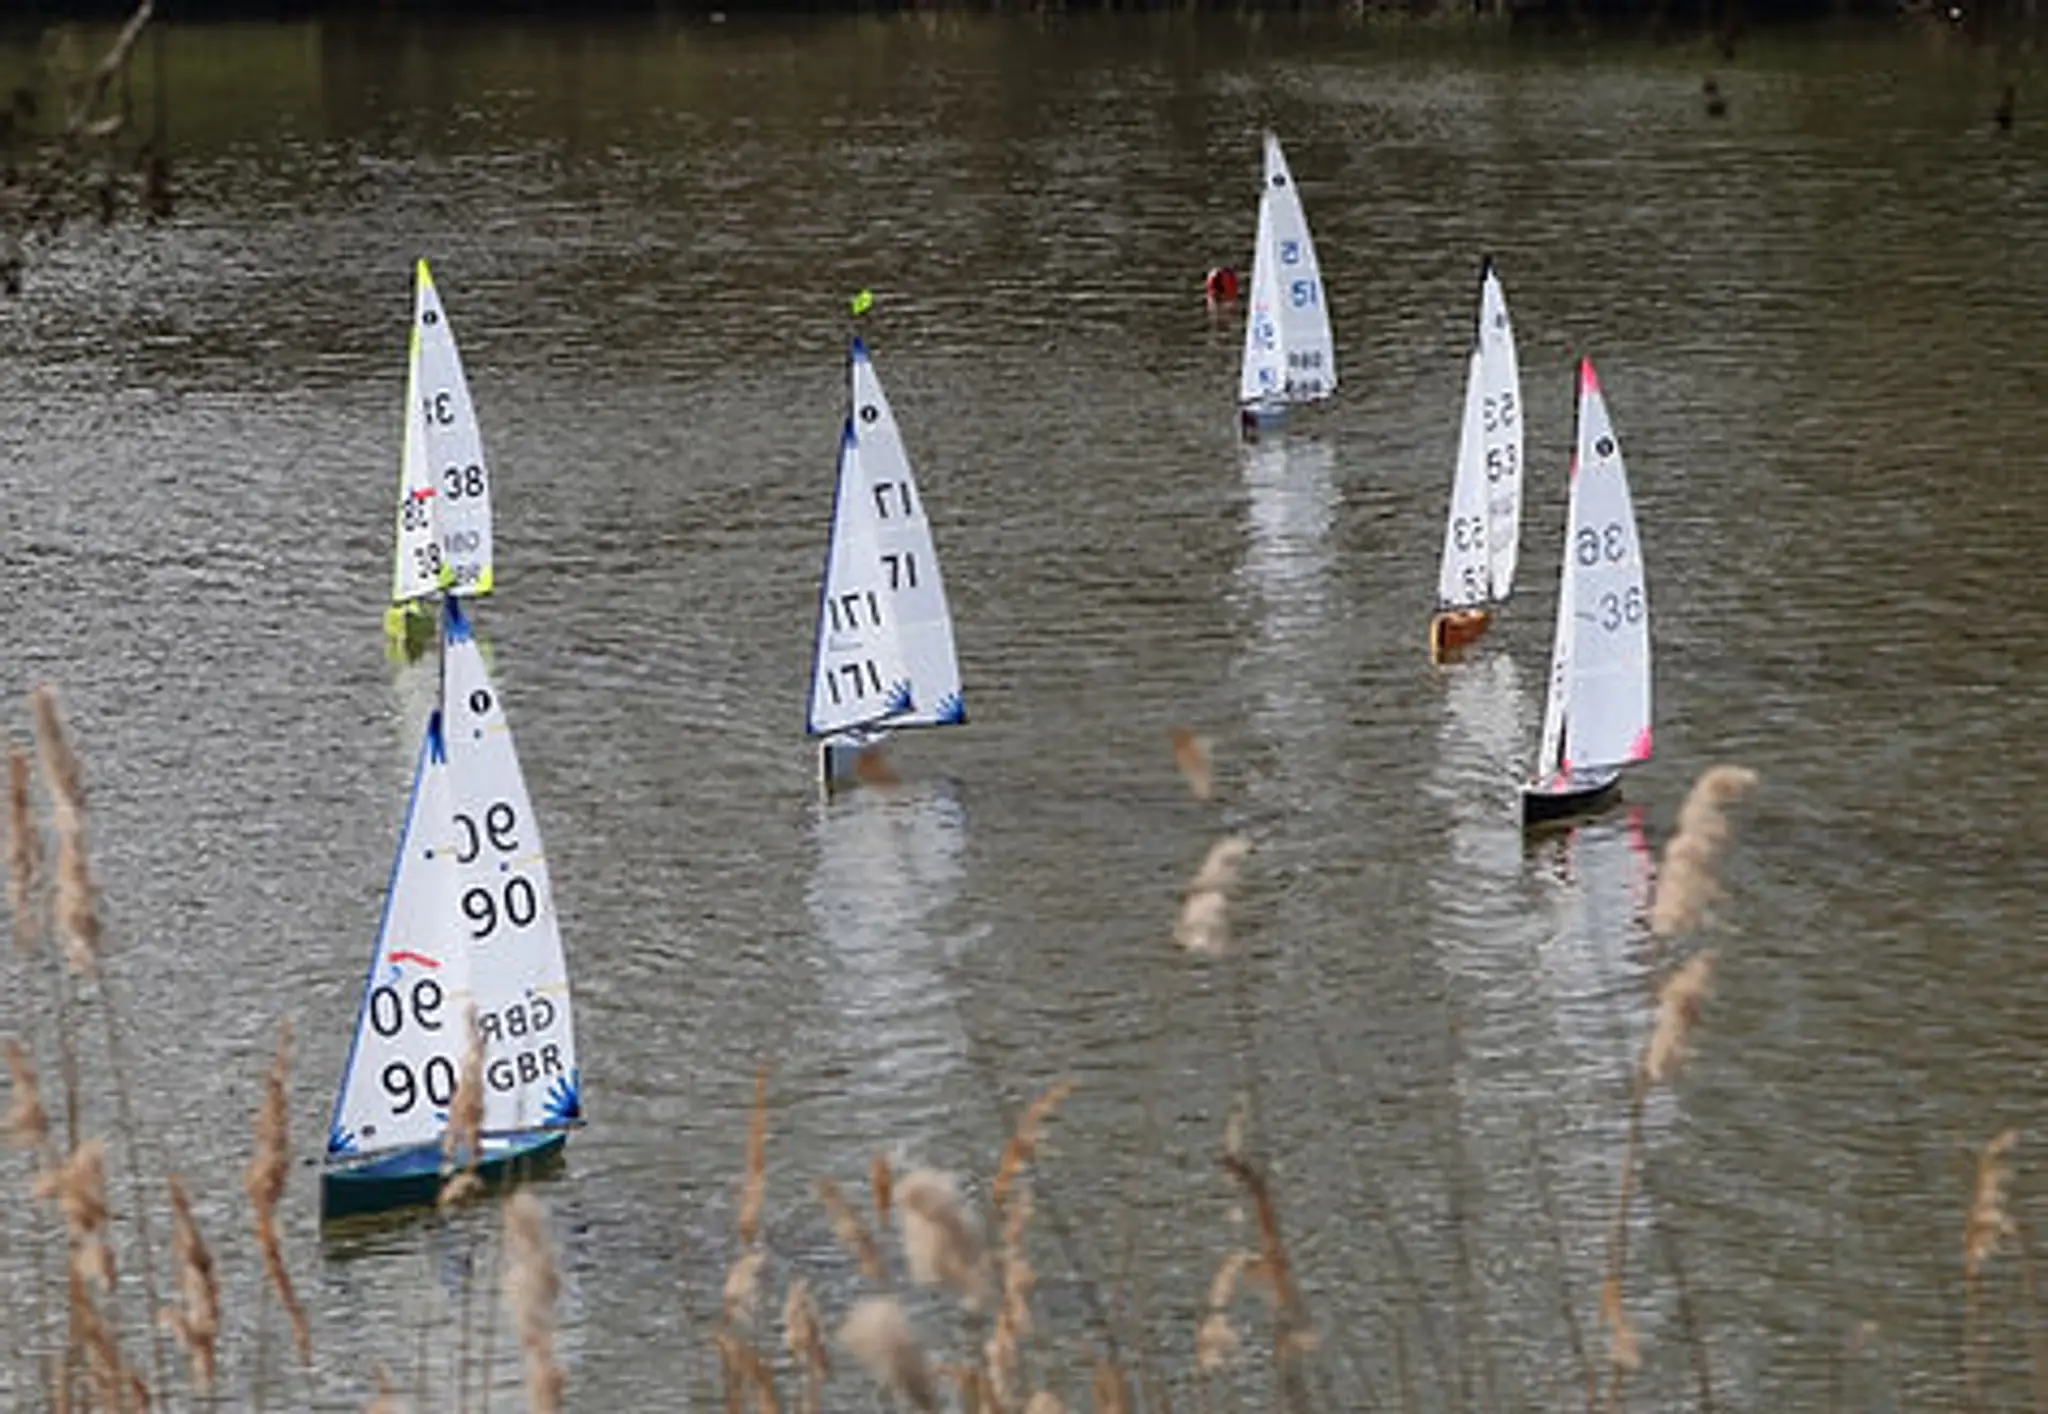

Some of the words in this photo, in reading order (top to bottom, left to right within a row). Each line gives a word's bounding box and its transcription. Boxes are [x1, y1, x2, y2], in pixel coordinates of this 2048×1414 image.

[1292, 279, 1317, 307] 51
[444, 465, 485, 500] 38
[1600, 586, 1644, 631] 36
[827, 659, 882, 704] 171
[461, 876, 537, 938] 90
[382, 1056, 457, 1114] 90
[486, 1044, 563, 1092] GBR
